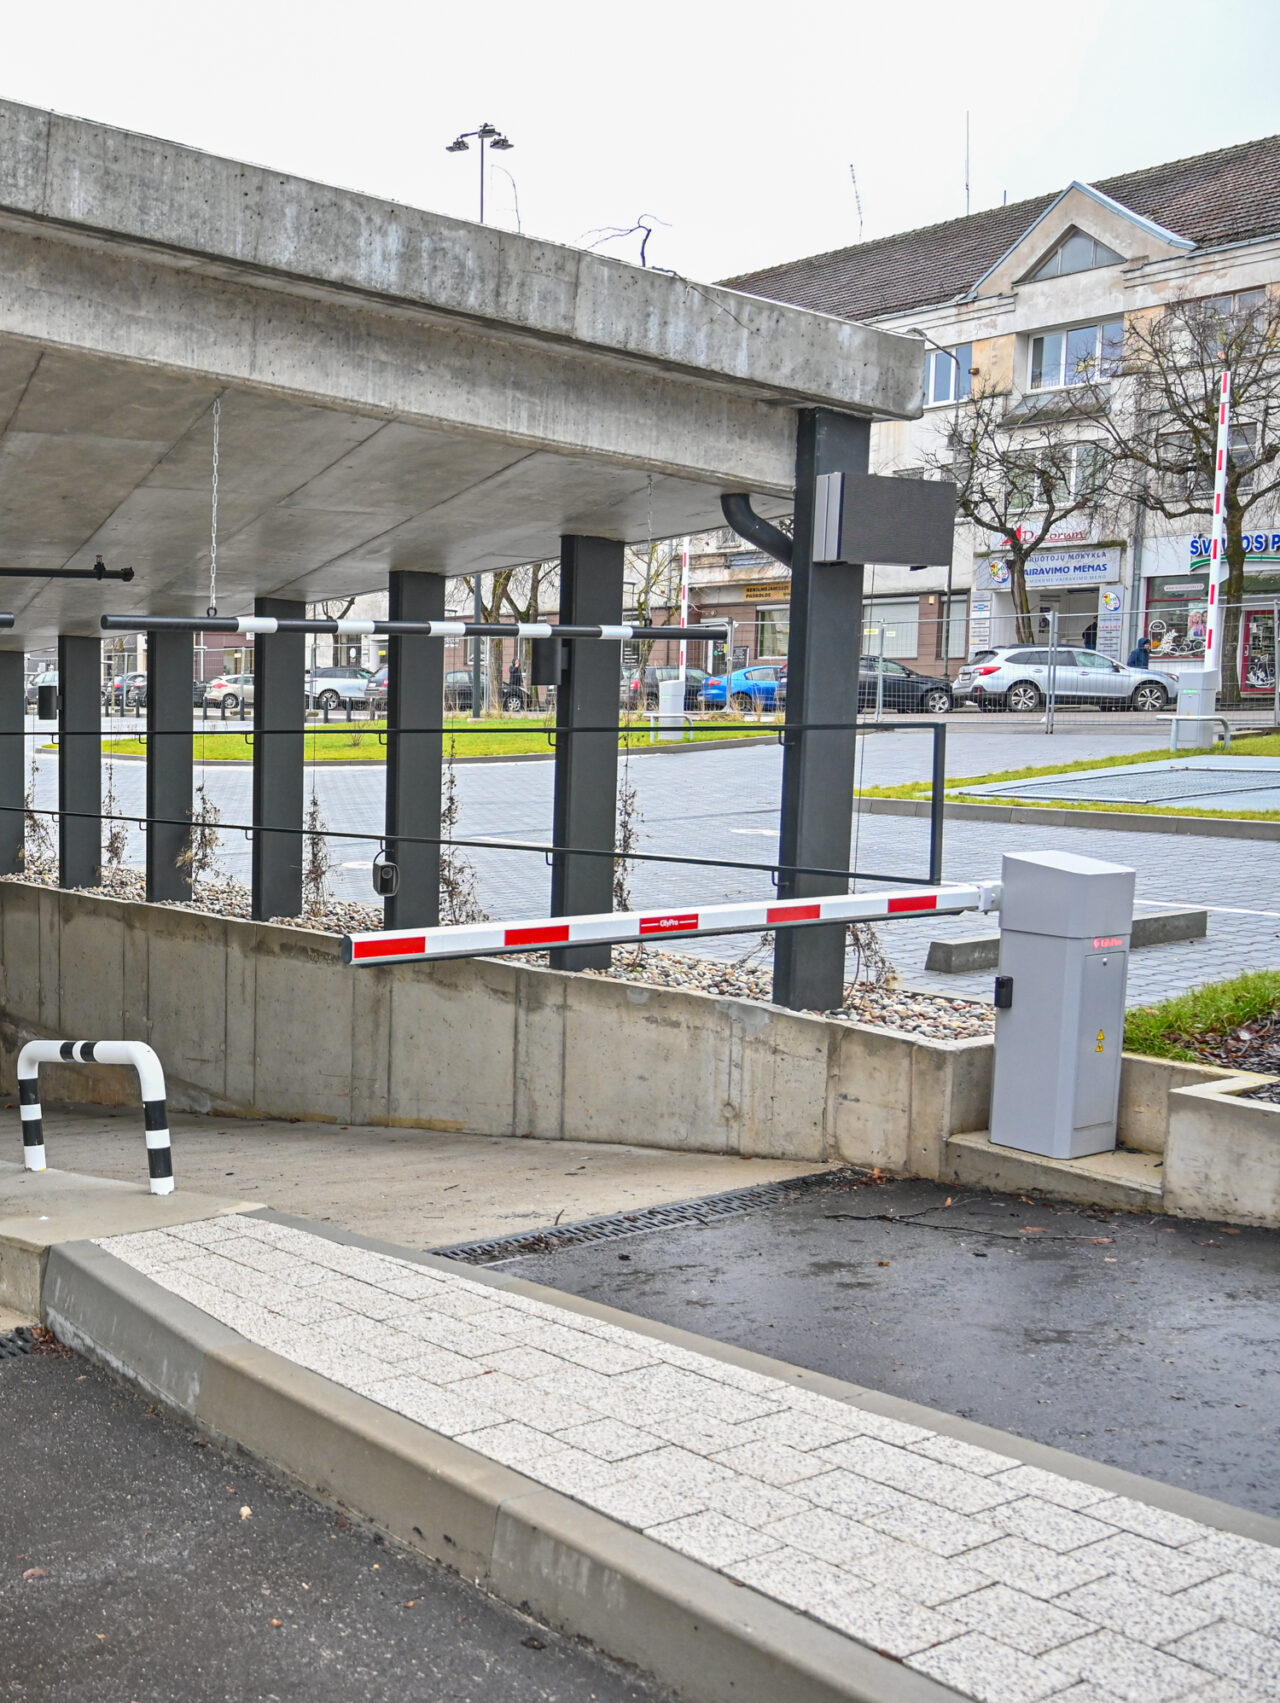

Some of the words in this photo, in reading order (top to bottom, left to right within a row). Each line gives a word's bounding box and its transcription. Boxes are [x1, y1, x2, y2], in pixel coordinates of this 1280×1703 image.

[1190, 534, 1264, 555] ŠVOS
[1068, 551, 1107, 560] MOKYKLA
[1024, 565, 1070, 576] AIRAVIMO
[1073, 563, 1108, 573] MENAS
[660, 919, 678, 928] CityPro
